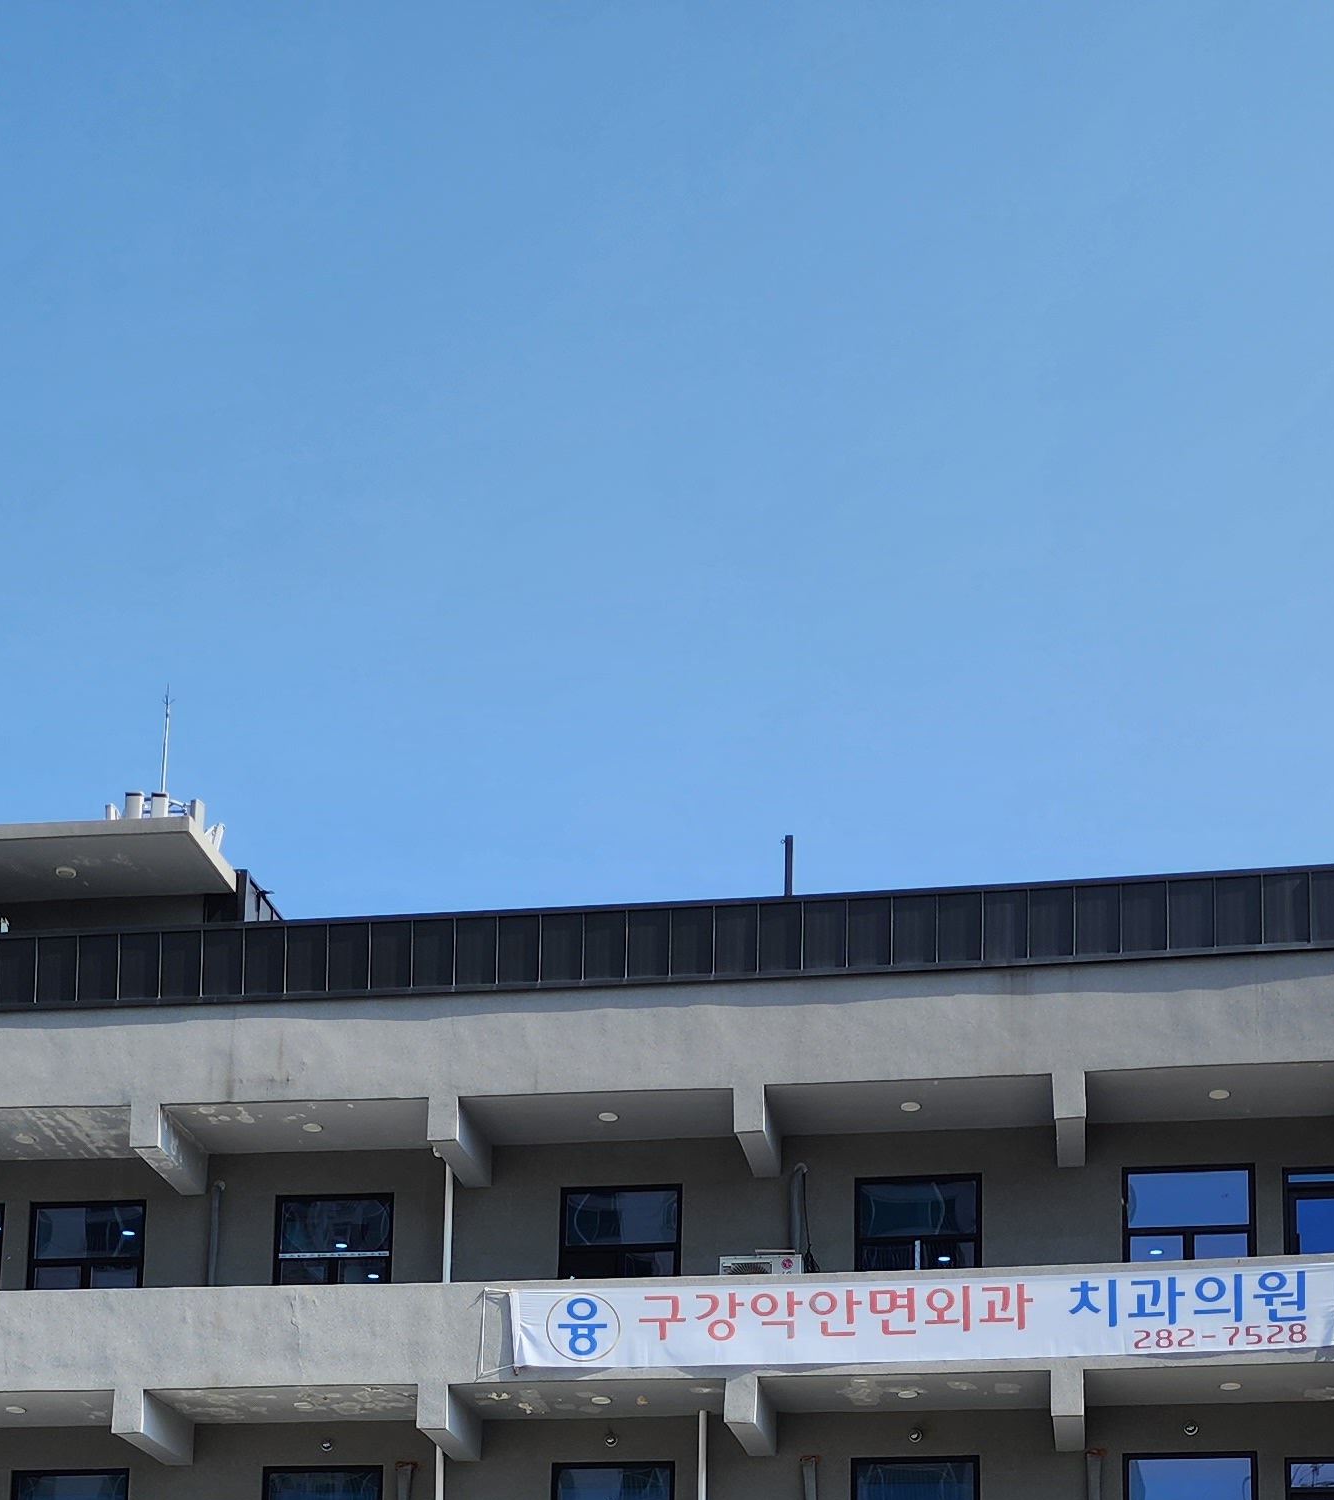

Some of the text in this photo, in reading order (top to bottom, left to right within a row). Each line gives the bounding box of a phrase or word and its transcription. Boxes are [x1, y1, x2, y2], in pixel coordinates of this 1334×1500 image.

[558, 1270, 1307, 1356] 융 구강악안면외과 치과의원
[1133, 1322, 1308, 1350] 282-7528
